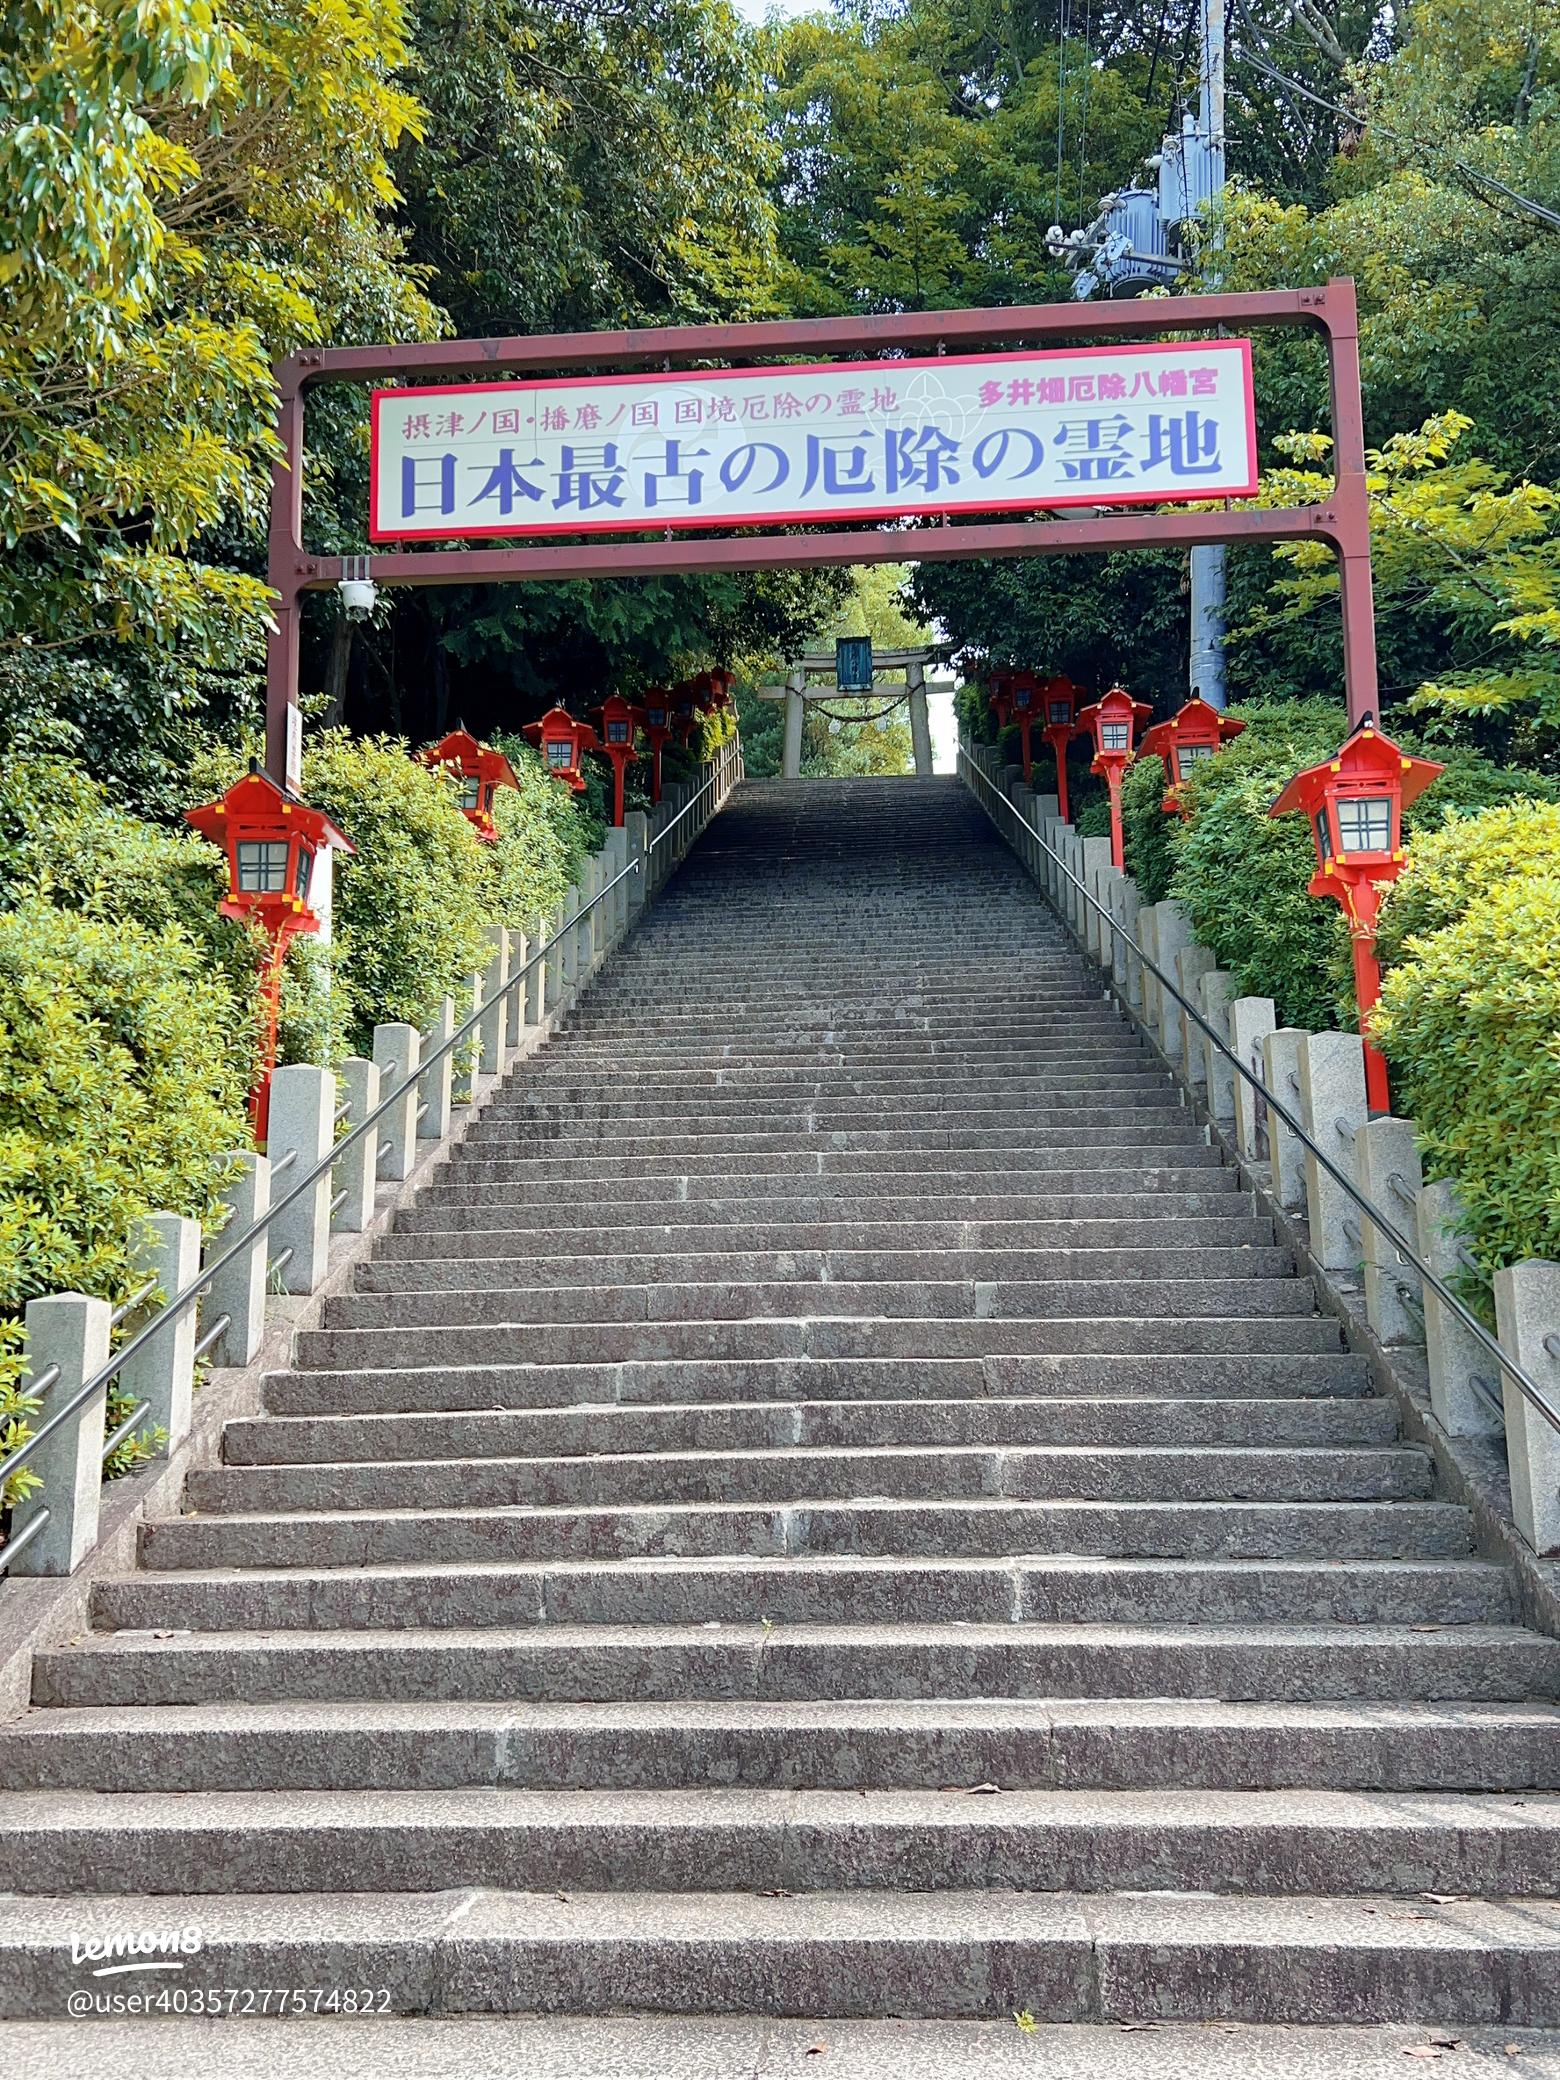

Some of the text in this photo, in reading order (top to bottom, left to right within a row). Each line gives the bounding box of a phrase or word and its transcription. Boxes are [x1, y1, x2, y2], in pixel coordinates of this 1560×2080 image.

[978, 367, 1219, 408] 多井畑厄除八幡宮
[401, 410, 1223, 518] 日本最古の厄除の霊地
